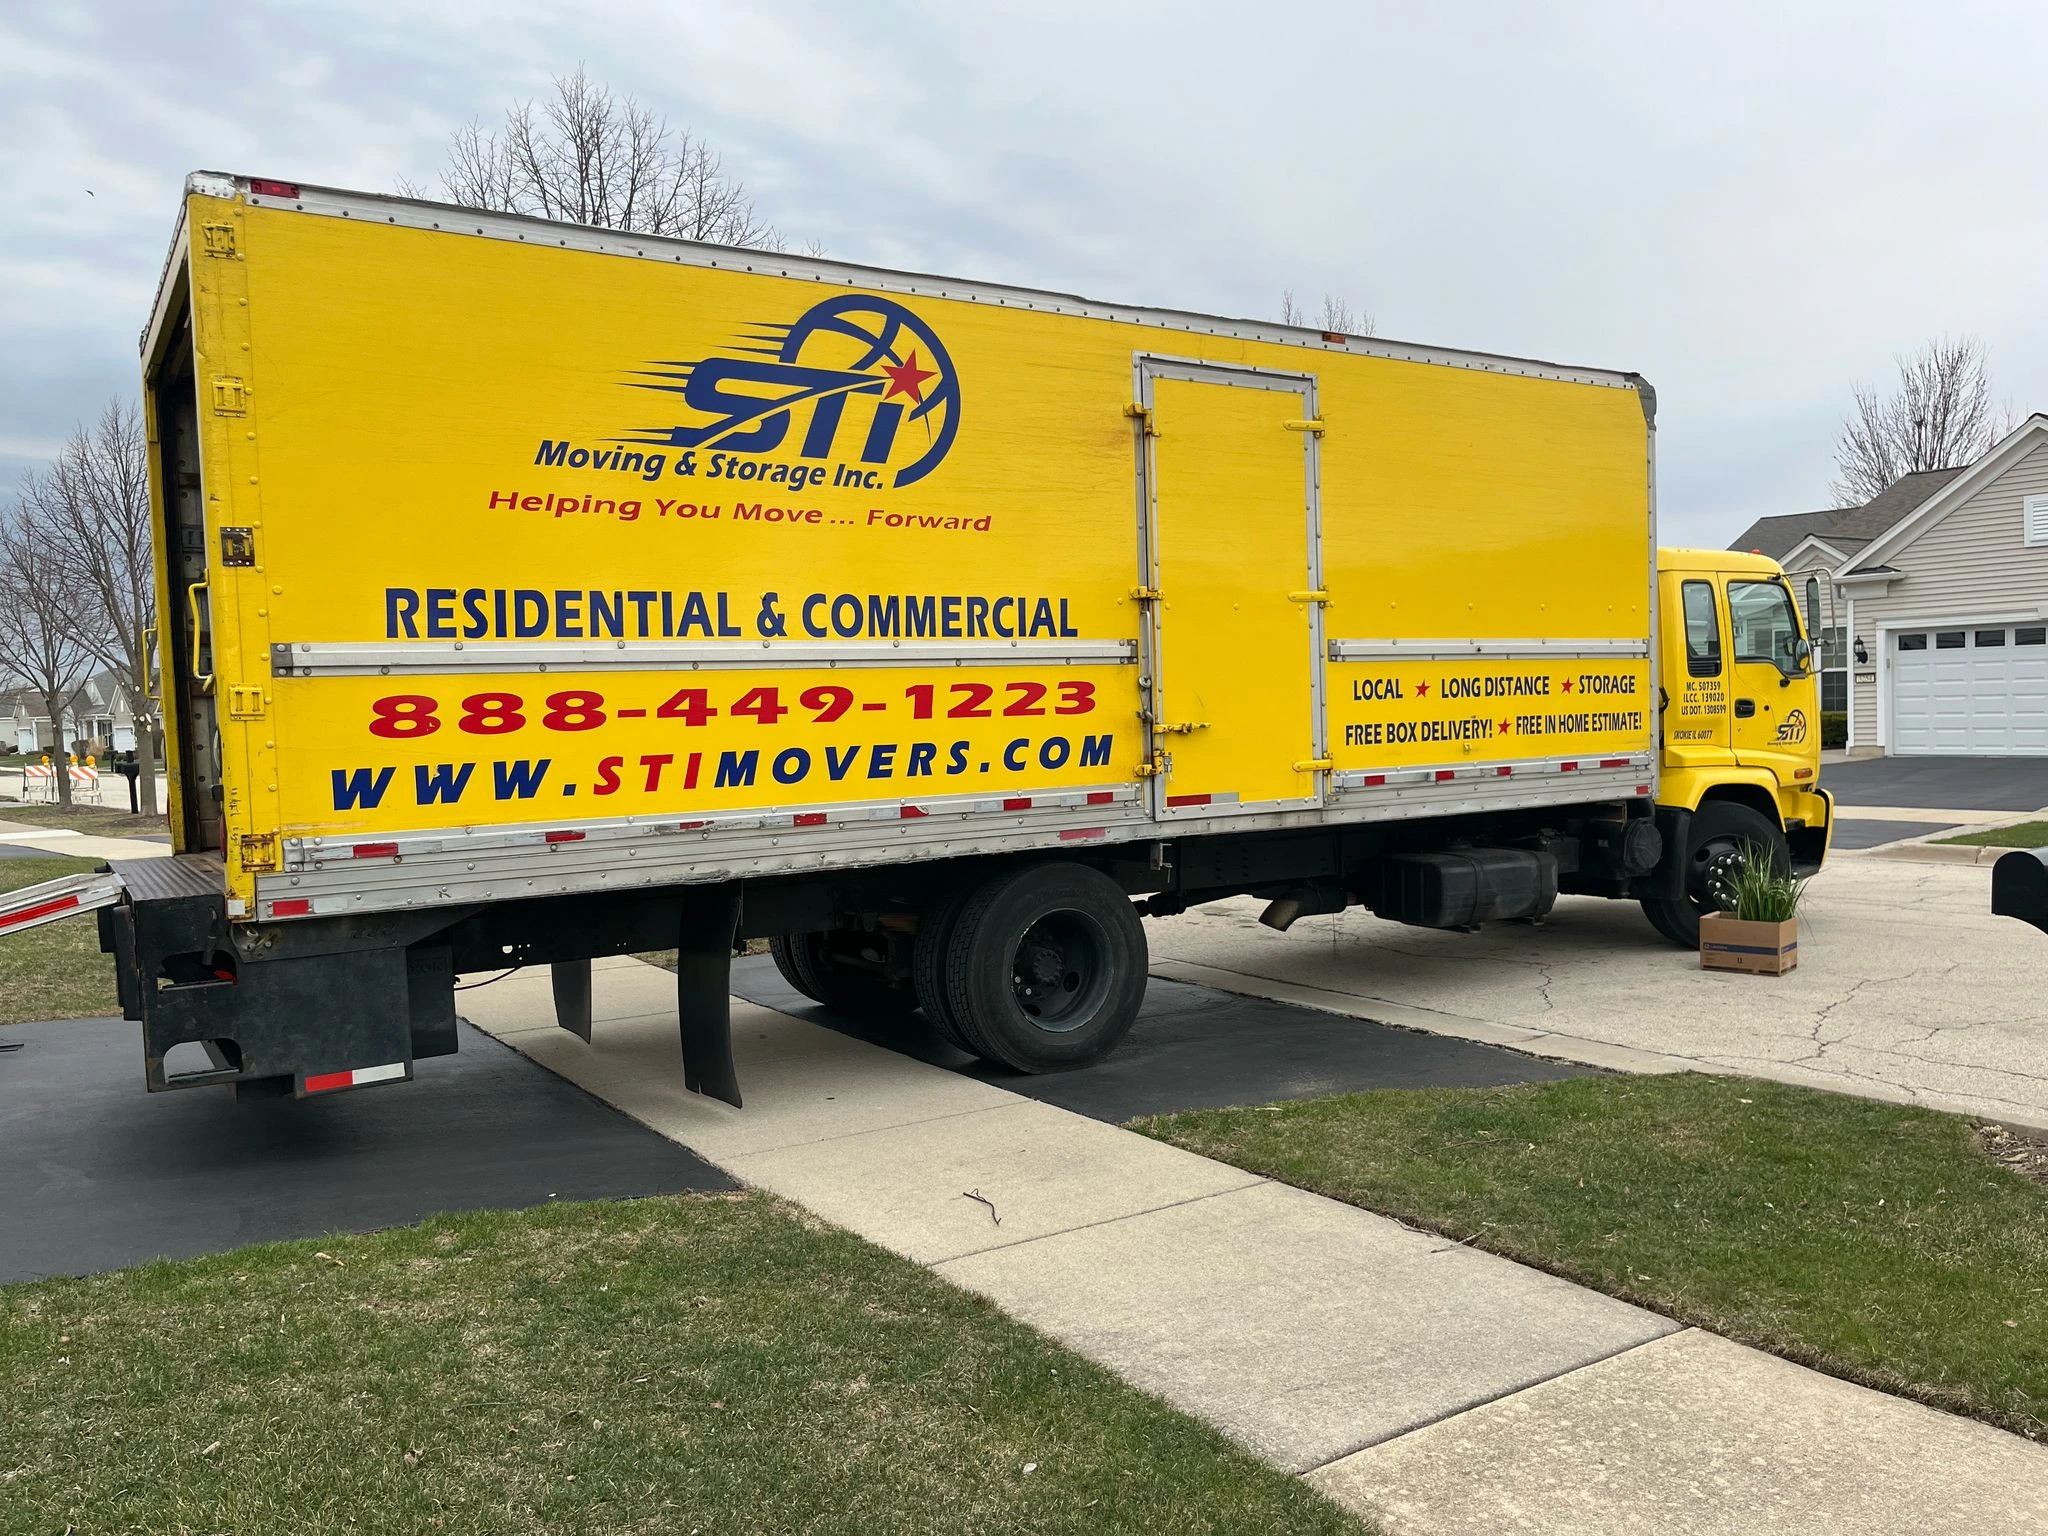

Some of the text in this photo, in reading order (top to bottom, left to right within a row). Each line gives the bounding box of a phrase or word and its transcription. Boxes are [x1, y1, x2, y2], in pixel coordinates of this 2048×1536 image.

[534, 439, 884, 491] Moving & Storage Inc.
[489, 491, 641, 521] Helping
[656, 499, 721, 519] You
[866, 509, 992, 532] Forward
[386, 587, 1078, 639] RESIDENTIAL & COMMERCIAL
[1353, 674, 1636, 701] LOCAL LONG DISTANCE STORAGE
[1686, 681, 1721, 691] MC. 507359
[1702, 692, 1725, 702] 139020
[369, 681, 1096, 739] 888-449-1223
[1681, 706, 1689, 715] US
[1704, 704, 1727, 714] 1308599
[1345, 711, 1642, 746] FREE BOX DELIVERY! FREE IN HOME ESTIMATE!
